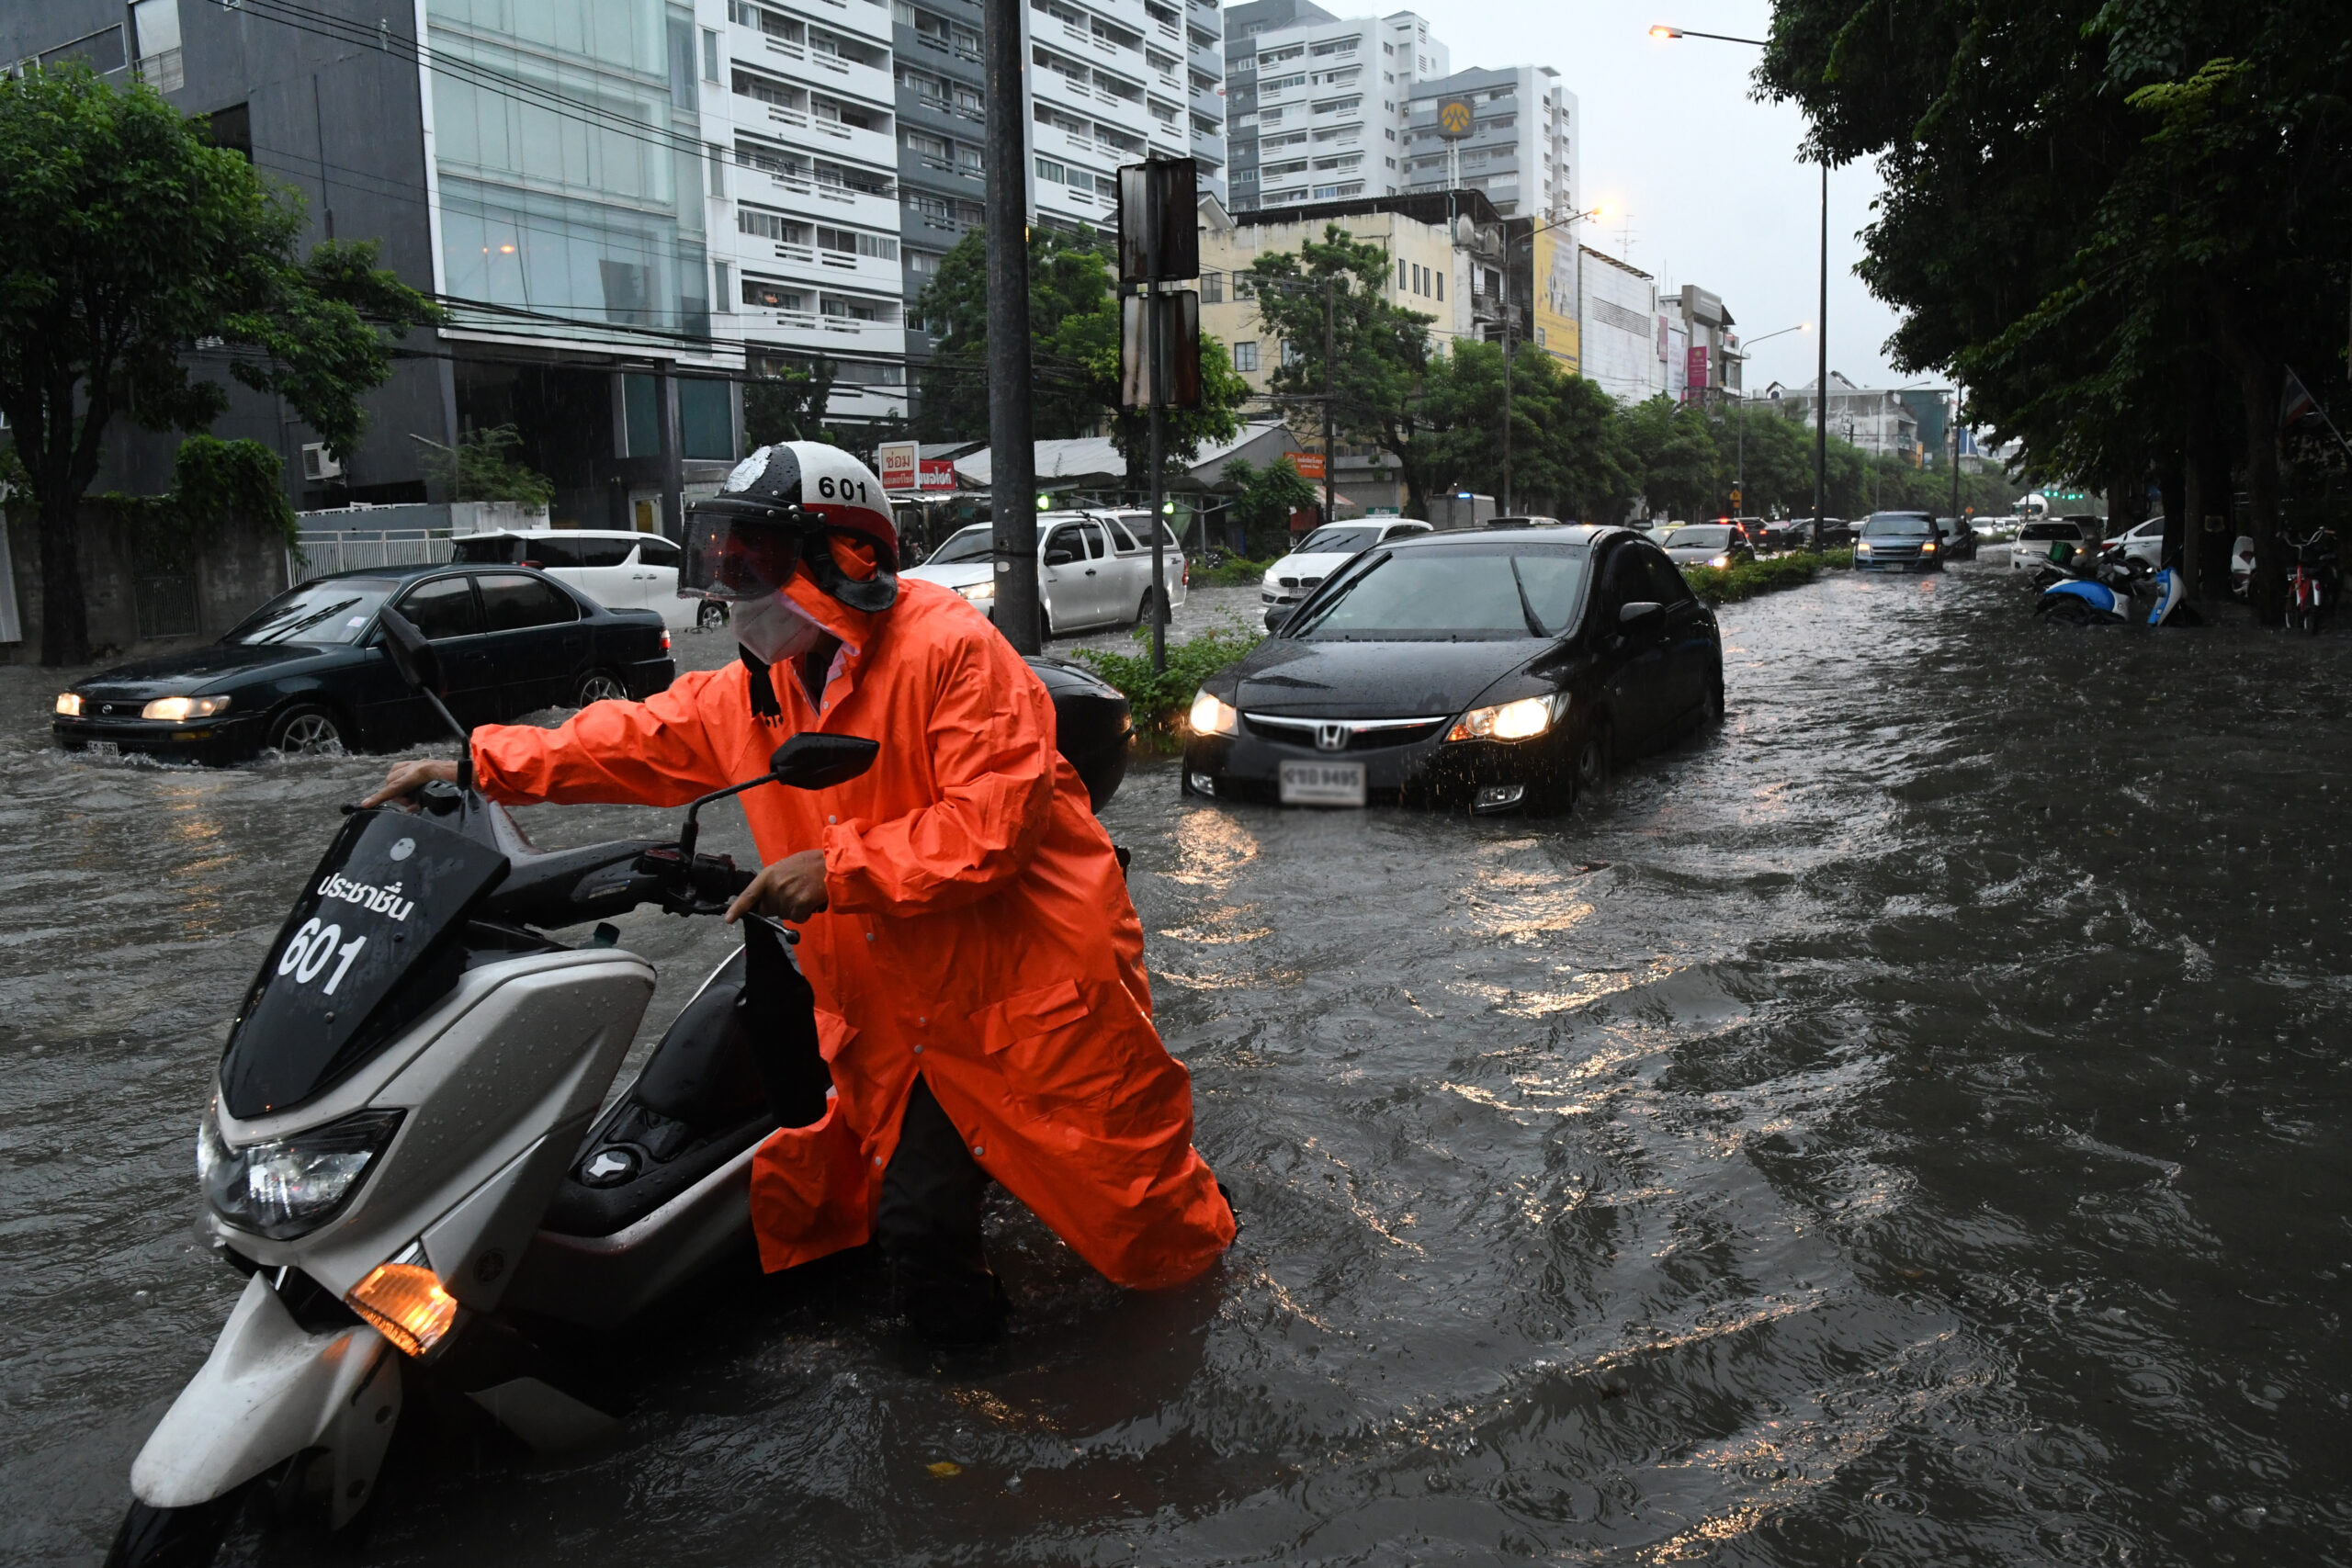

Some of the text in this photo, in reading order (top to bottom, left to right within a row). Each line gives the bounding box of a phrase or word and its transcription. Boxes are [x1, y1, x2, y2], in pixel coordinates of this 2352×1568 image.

[886, 451, 910, 468] ซ่อม
[819, 477, 866, 502] 601
[317, 873, 414, 921] ประชาชื่น
[277, 917, 368, 996] 601
